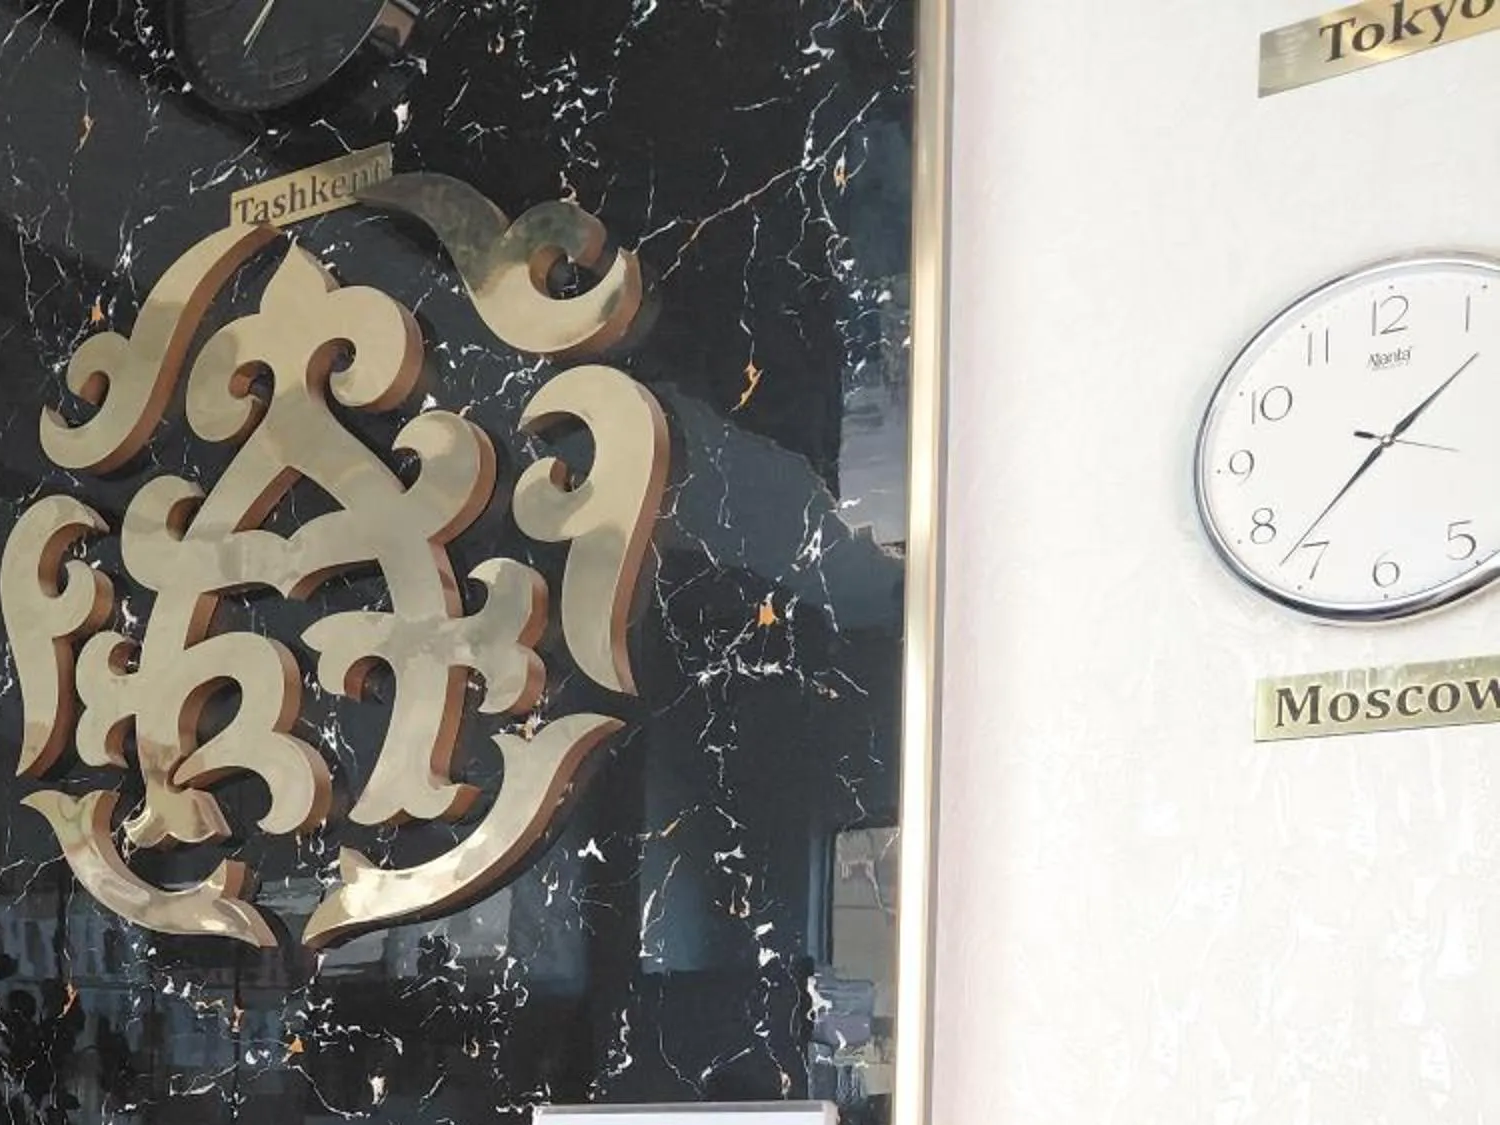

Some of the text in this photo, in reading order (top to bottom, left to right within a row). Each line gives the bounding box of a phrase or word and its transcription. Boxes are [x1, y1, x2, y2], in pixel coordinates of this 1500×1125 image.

[1319, 0, 1495, 62] Tokyo
[1372, 295, 1409, 336] 12
[1306, 327, 1329, 367] 11
[1251, 385, 1293, 425] 10
[1228, 449, 1255, 487] 9
[1250, 507, 1277, 545] 8
[1447, 519, 1477, 560] 5
[1302, 540, 1330, 580] 7
[1372, 550, 1400, 588] 6
[1275, 678, 1500, 728] Moscow
